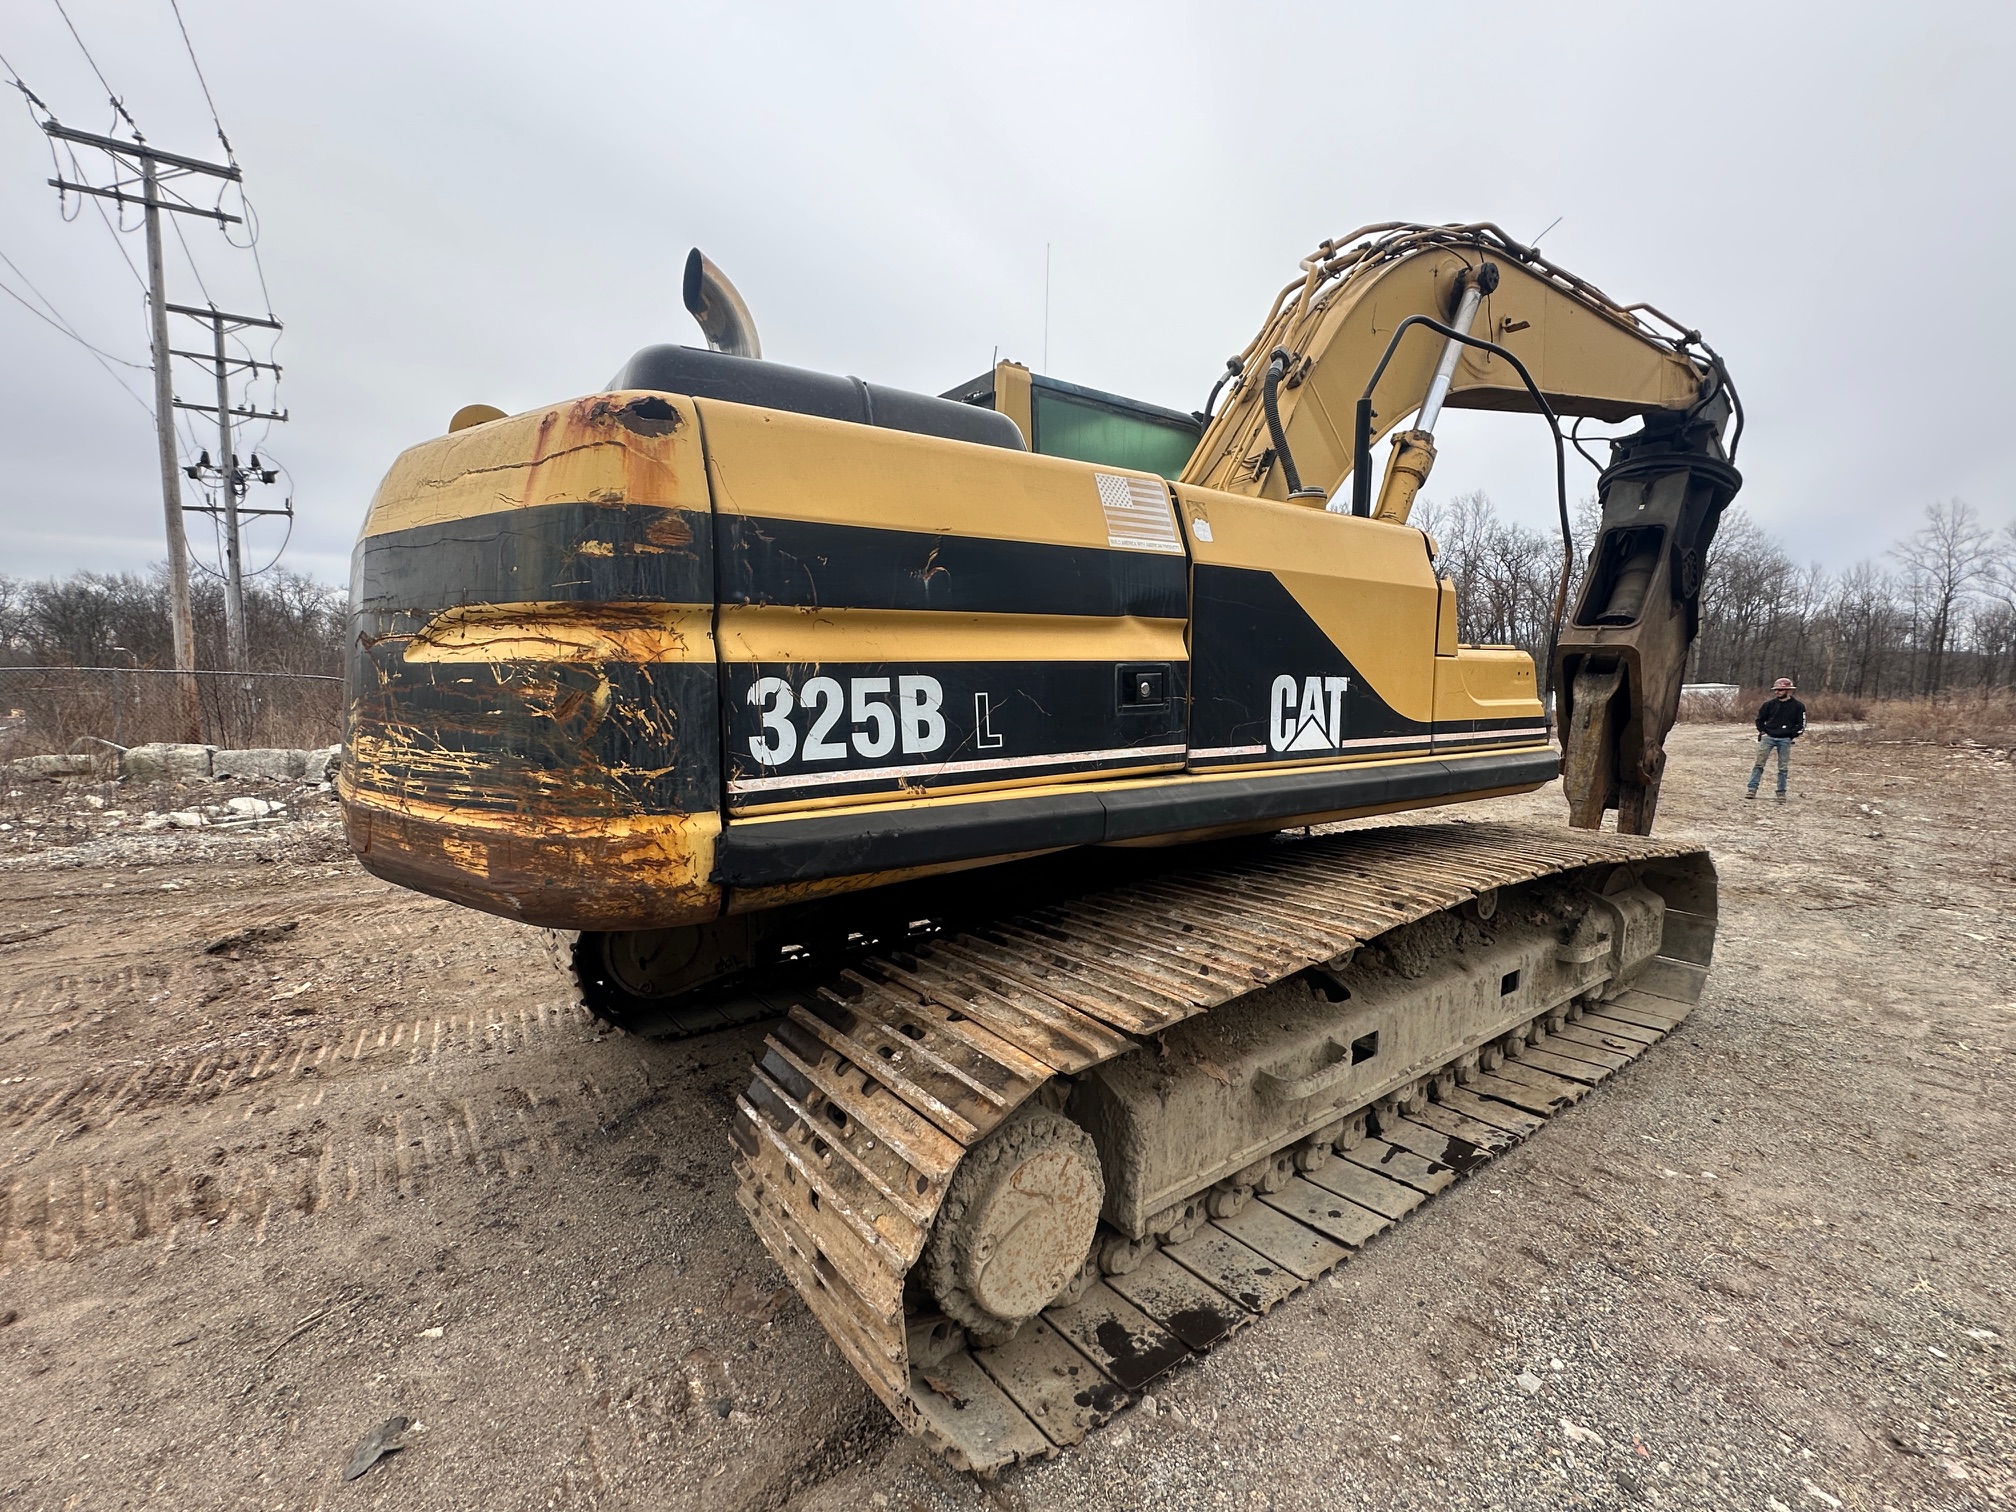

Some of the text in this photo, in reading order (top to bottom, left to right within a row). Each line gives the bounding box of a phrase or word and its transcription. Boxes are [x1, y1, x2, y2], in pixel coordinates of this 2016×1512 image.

[746, 674, 1003, 766] 325B L
[1270, 674, 1348, 752] CAT
